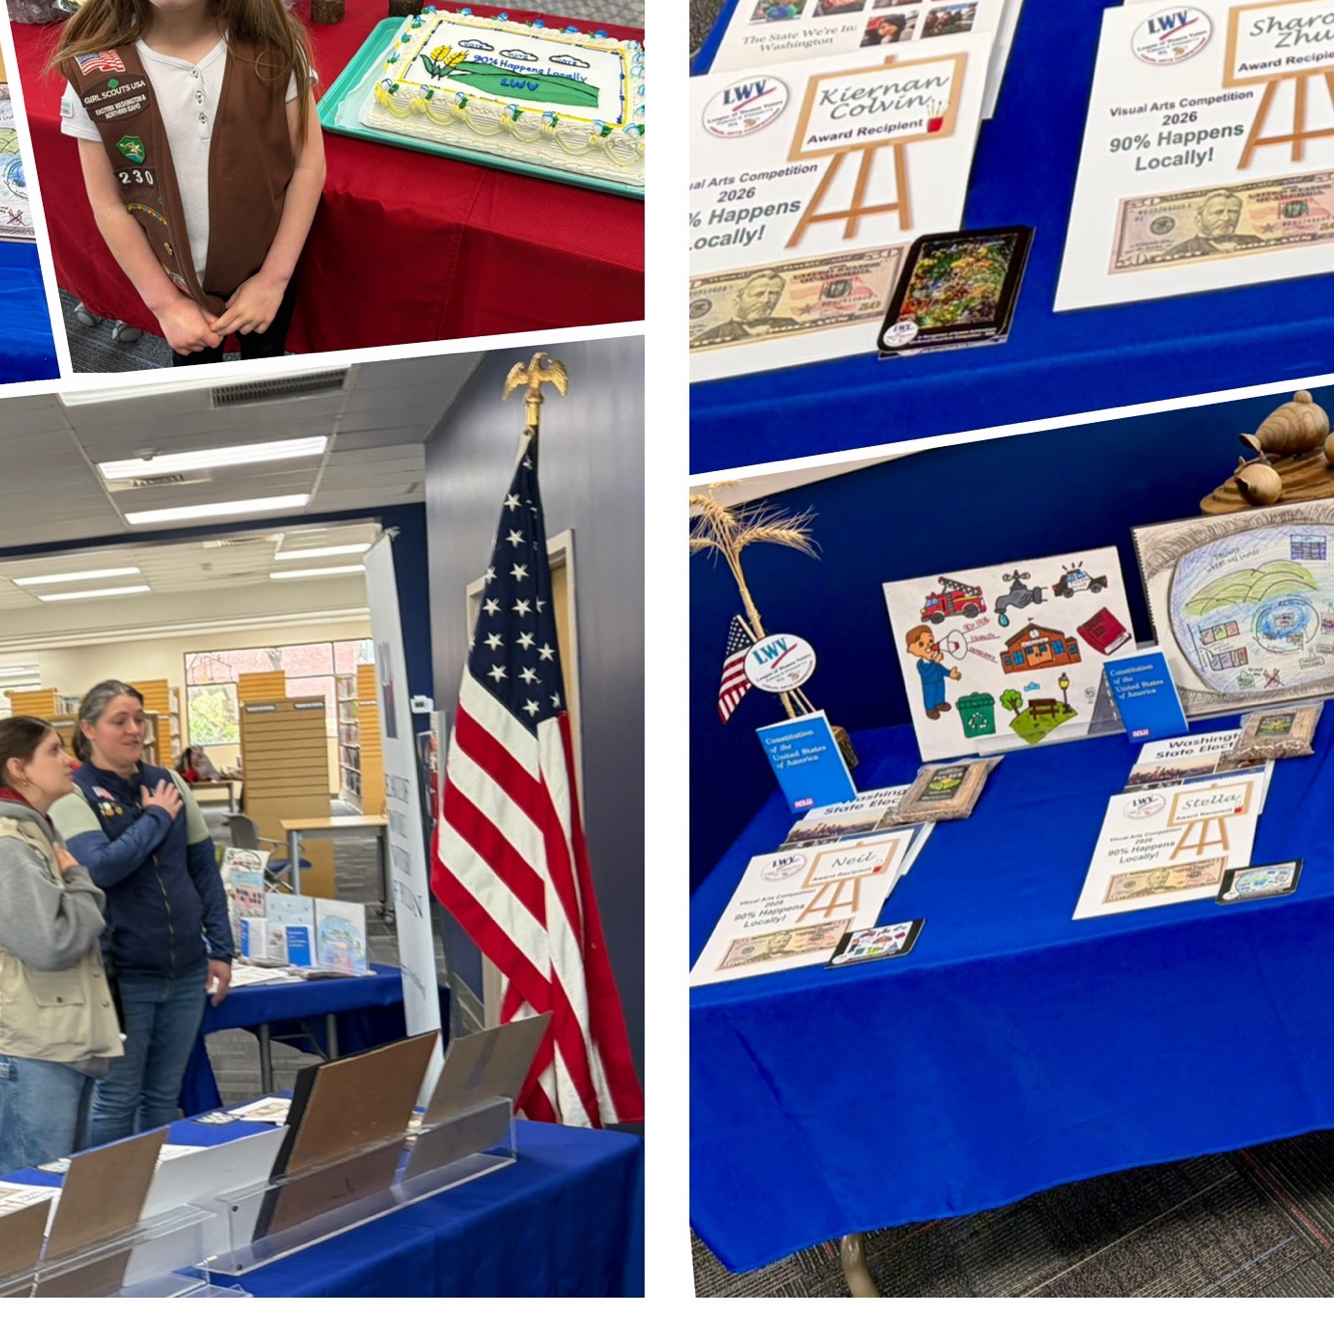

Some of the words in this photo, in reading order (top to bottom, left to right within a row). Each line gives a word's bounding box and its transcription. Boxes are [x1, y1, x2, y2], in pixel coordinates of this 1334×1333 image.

[473, 54, 499, 66] 90%
[500, 59, 544, 76] Happens
[547, 68, 588, 83] Locally
[1238, 56, 1282, 73] Award
[83, 95, 101, 105] GIRL
[101, 85, 131, 100] SCOUTS
[131, 80, 146, 90] USA
[500, 77, 539, 91] LWV
[819, 74, 948, 107] Kiernan
[830, 93, 934, 122] Colvin
[1110, 104, 1148, 118] Visual
[1150, 98, 1176, 112] Arts
[1178, 89, 1254, 109] Competition
[1162, 110, 1198, 126] 2026
[1109, 134, 1151, 154] 90%
[1156, 122, 1245, 150] Happens
[1134, 146, 1215, 171] Locally!
[119, 169, 154, 185] 230
